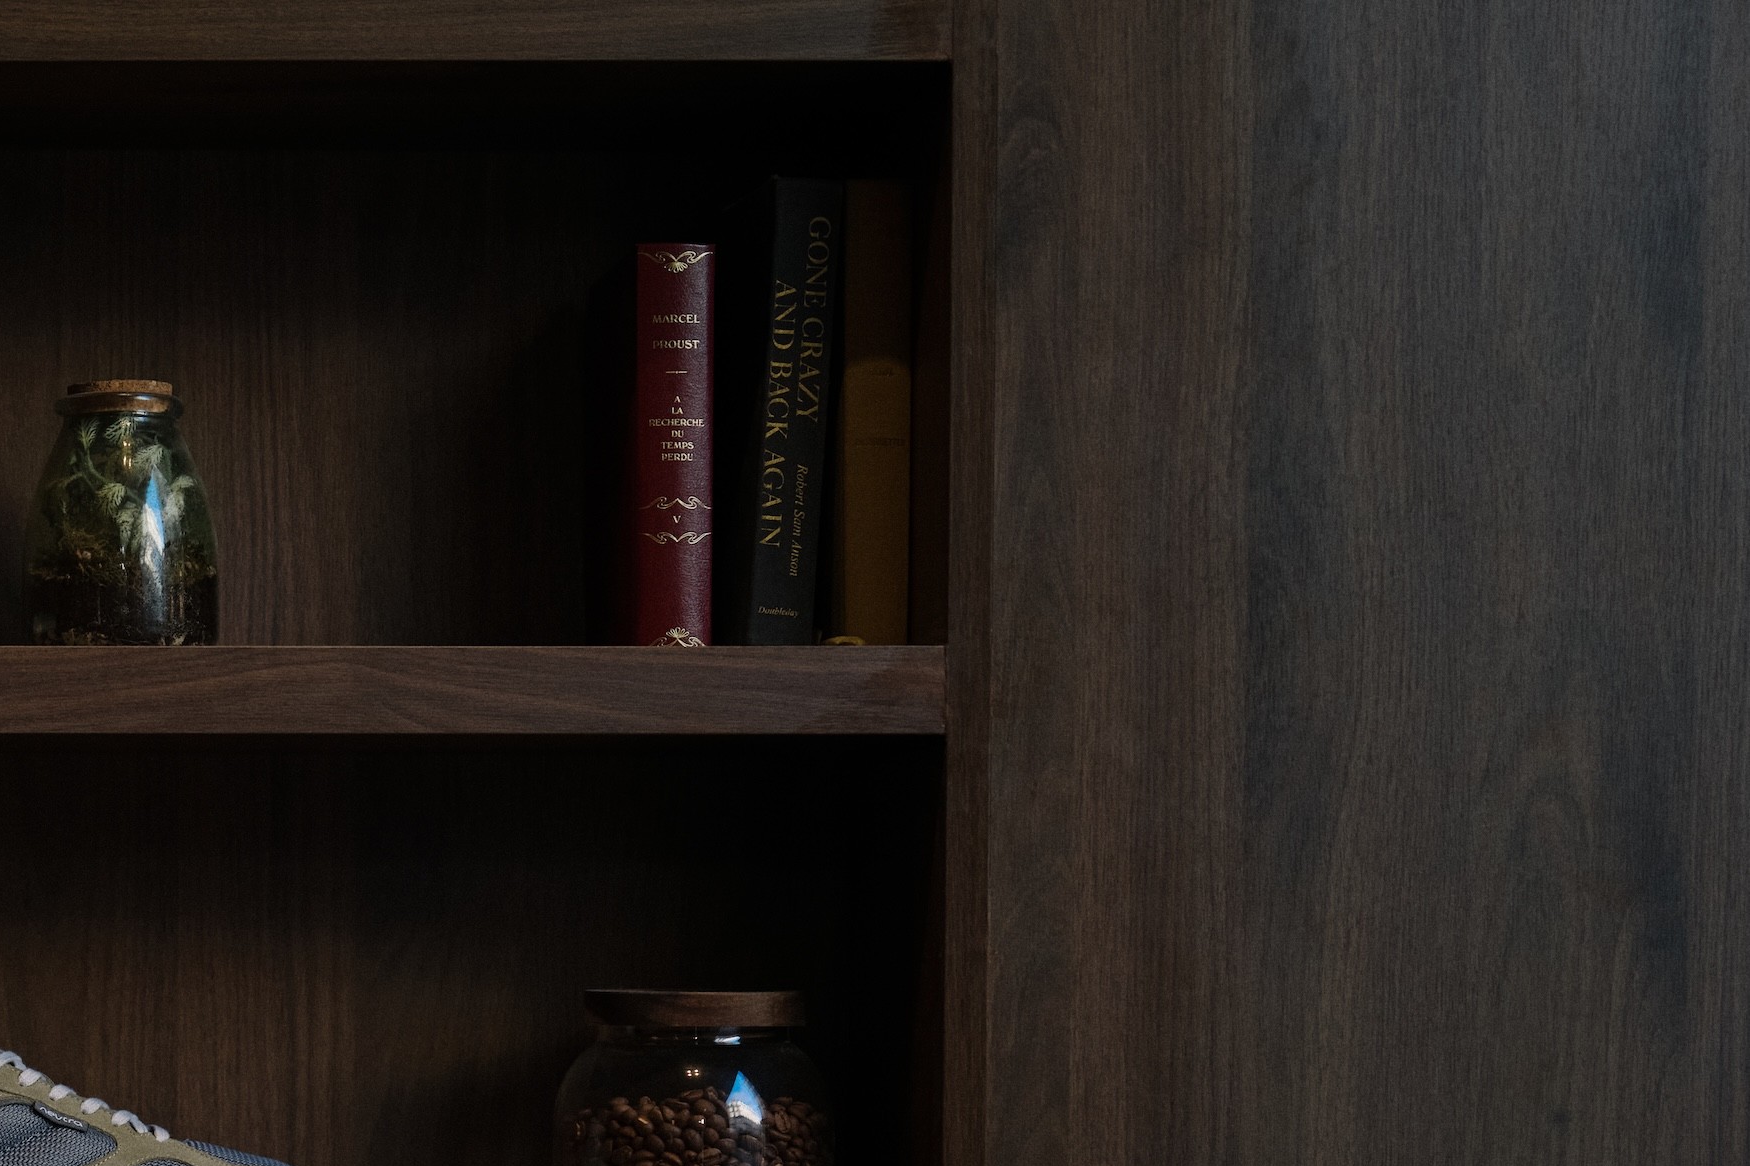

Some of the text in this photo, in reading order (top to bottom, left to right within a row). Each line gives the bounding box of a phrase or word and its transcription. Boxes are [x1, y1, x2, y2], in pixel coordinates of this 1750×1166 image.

[652, 314, 700, 324] MARCEL
[796, 216, 832, 423] GONE CRAZY
[652, 339, 700, 349] PROUST
[674, 395, 681, 403] A
[671, 407, 684, 415] LA
[759, 279, 797, 548] AND BACK AGAIN
[649, 418, 704, 427] RECHERCHE
[671, 430, 684, 438] DU
[661, 441, 694, 450] TEMPS
[661, 452, 694, 461] PERDU
[795, 463, 809, 506] Robert
[672, 515, 682, 524] V
[792, 508, 806, 537] Sam
